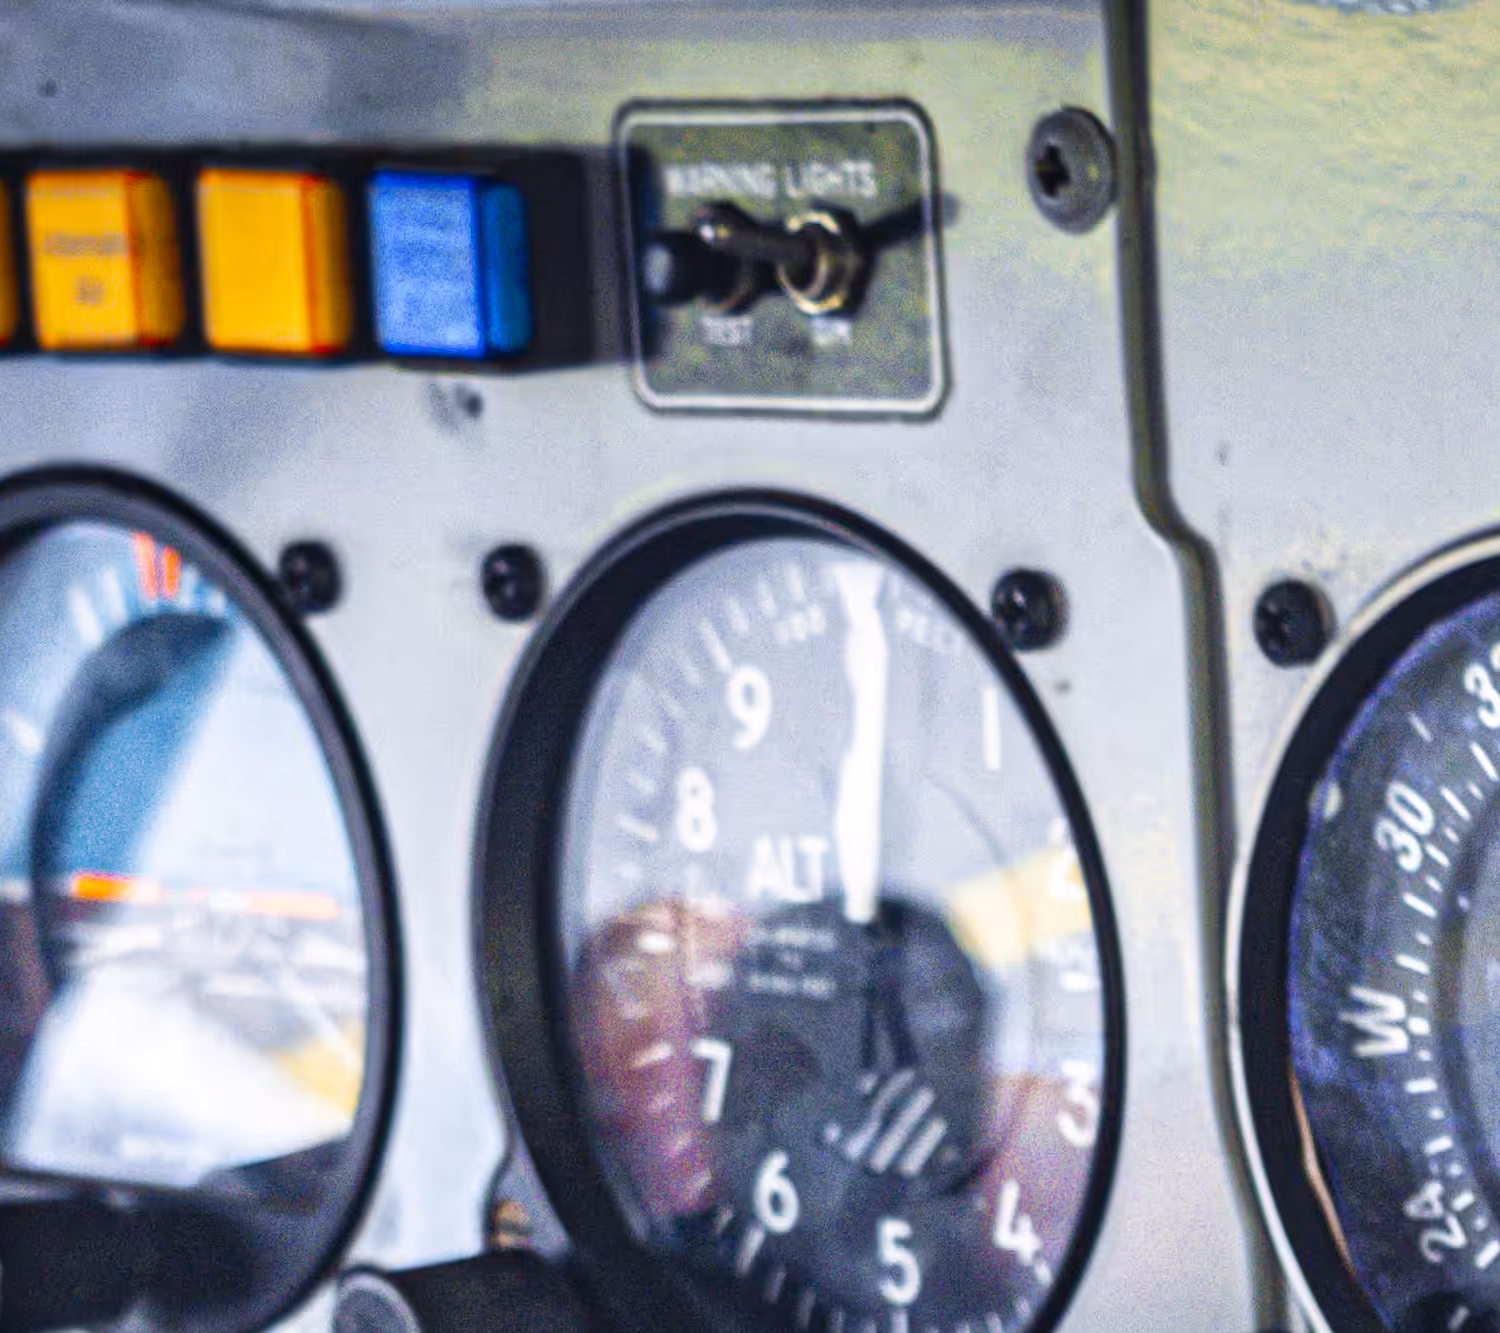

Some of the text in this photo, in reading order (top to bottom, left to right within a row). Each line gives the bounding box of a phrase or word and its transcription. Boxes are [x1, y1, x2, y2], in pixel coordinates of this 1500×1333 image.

[727, 665, 772, 751] 9
[676, 766, 718, 853] 8
[1376, 780, 1437, 872] 30
[749, 834, 828, 902] ALT
[1337, 983, 1409, 1060] W
[690, 1039, 732, 1124] 7
[755, 1151, 800, 1234] 6
[991, 1180, 1041, 1262] 4
[877, 1217, 923, 1306] 5
